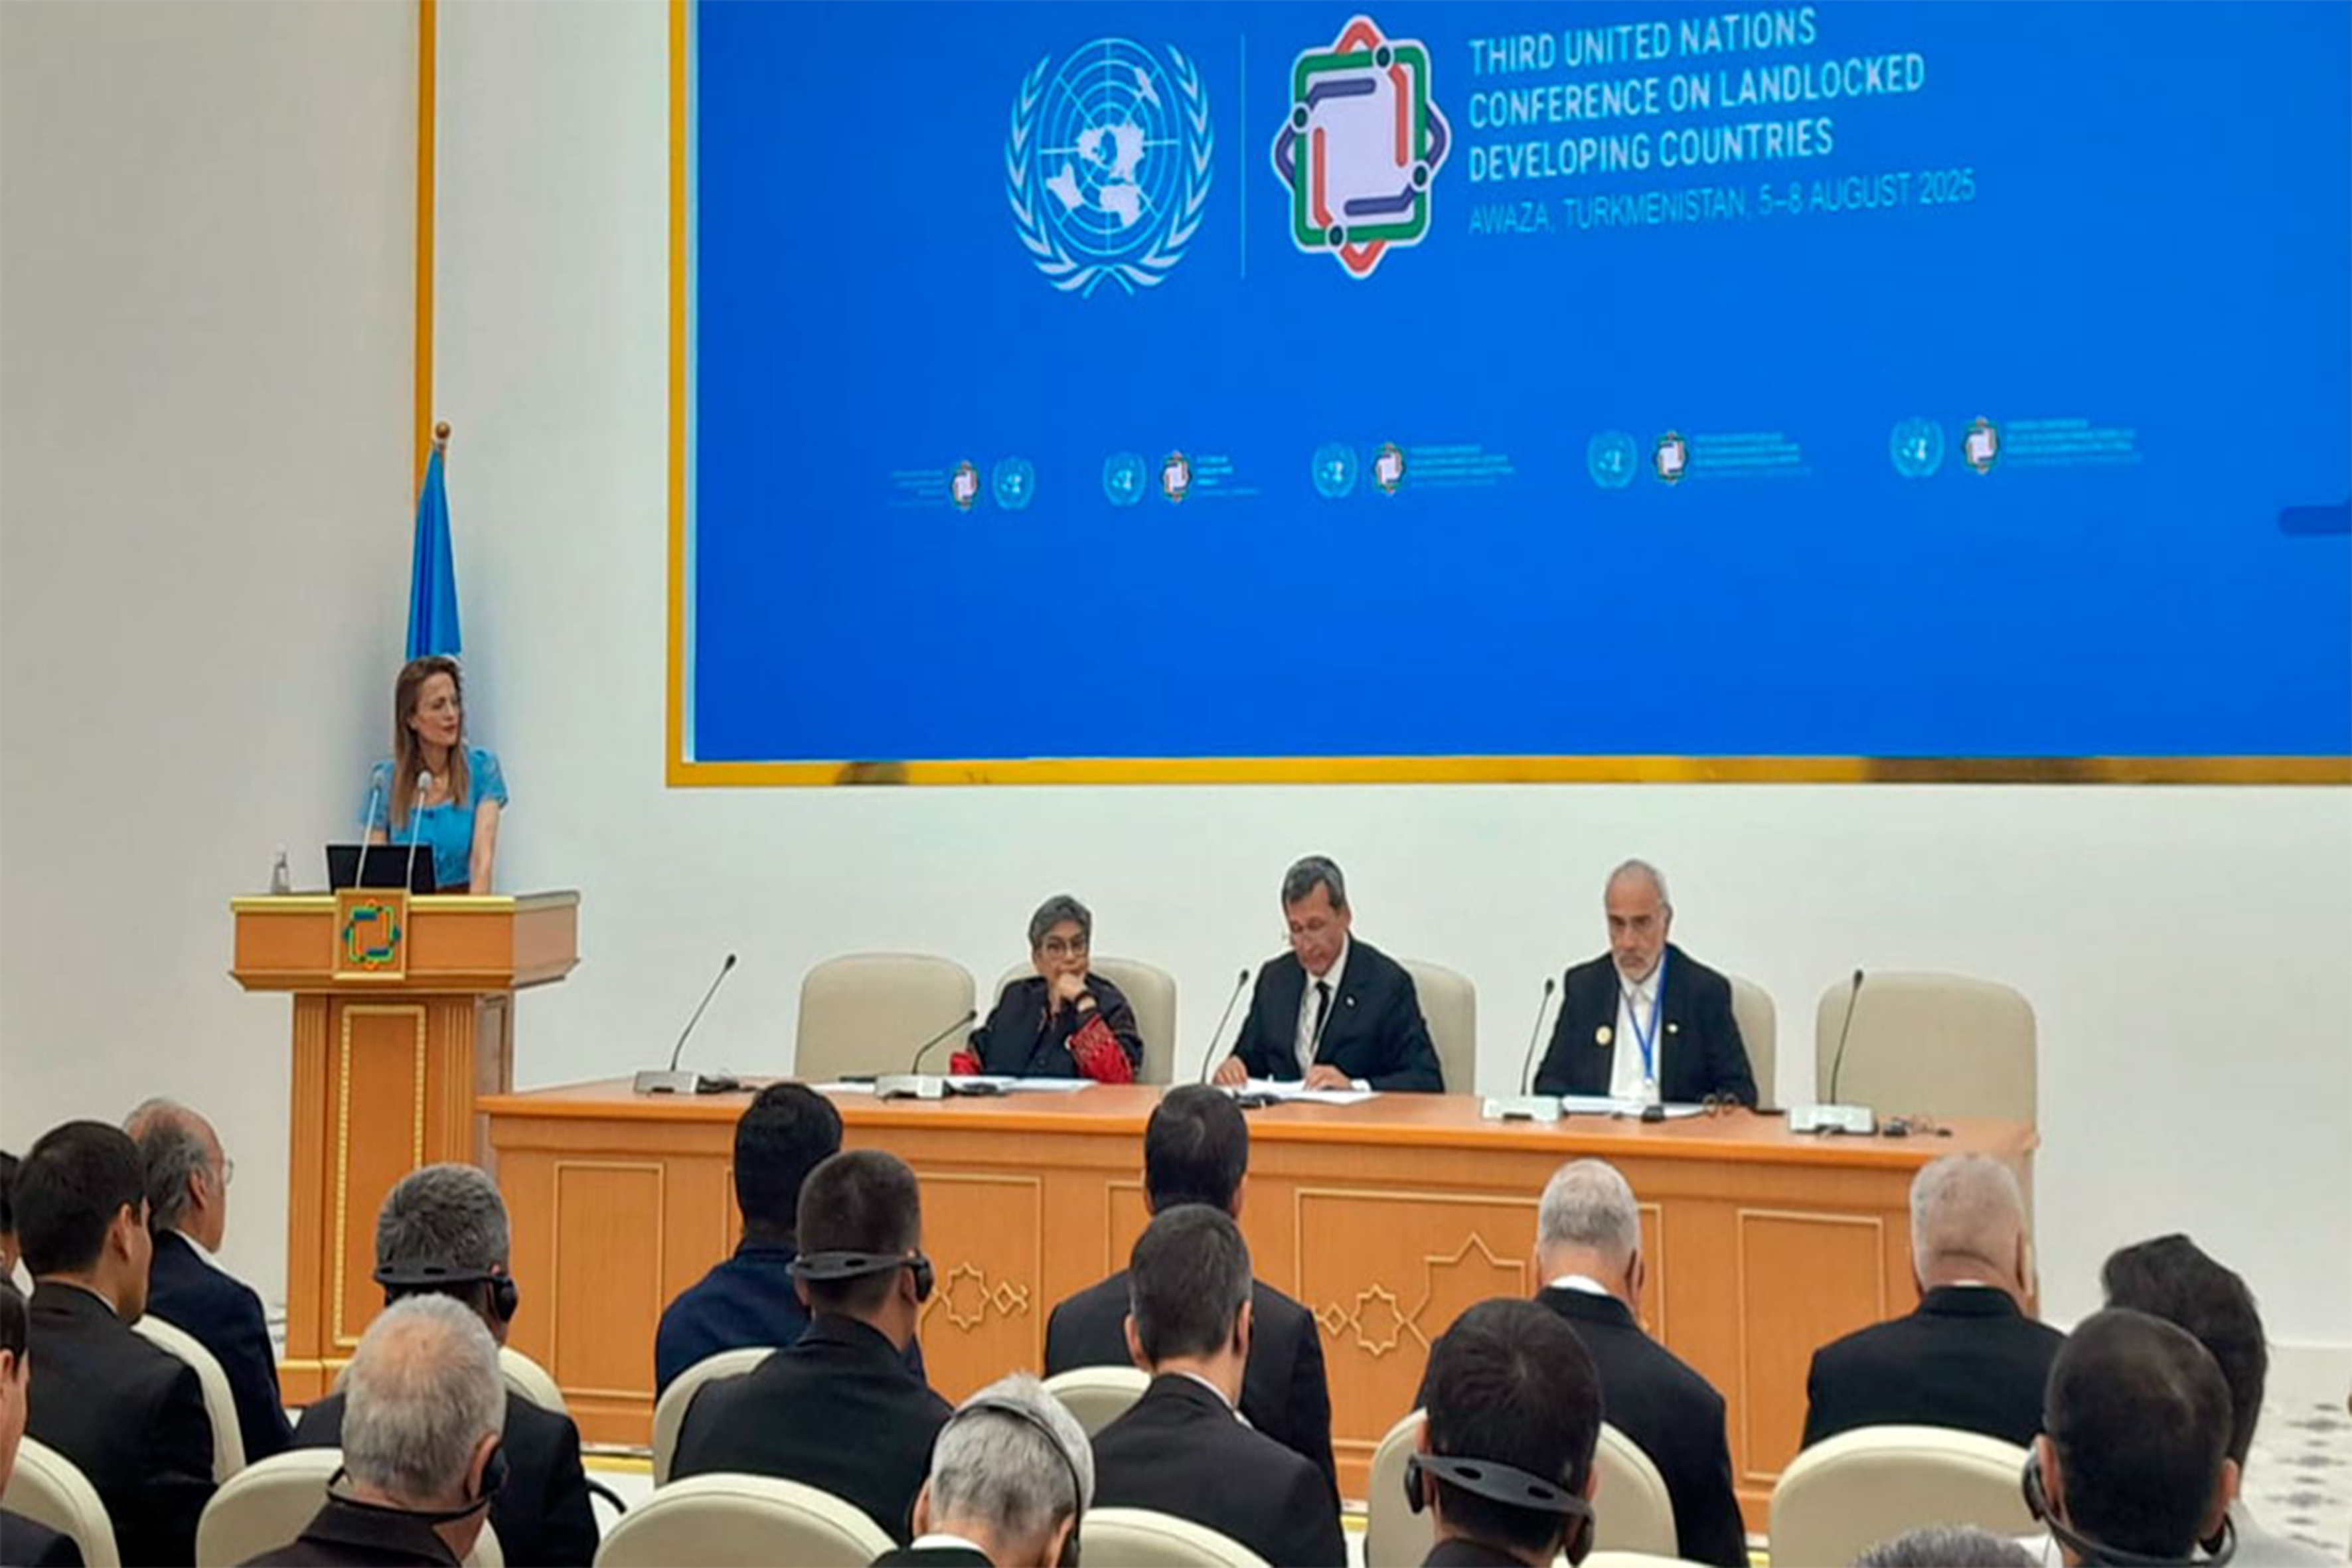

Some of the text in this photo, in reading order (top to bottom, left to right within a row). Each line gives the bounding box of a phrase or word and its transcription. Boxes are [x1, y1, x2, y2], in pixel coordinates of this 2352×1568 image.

[1468, 7, 1816, 75] THIRD UNITED NATIONS
[1469, 53, 1924, 128] CONFERENCE ON LANDLOCKED
[1469, 118, 1833, 182] DEVELOPING COUNTRIES
[1809, 171, 1910, 212] AUGUST
[1920, 168, 1976, 204] 2025
